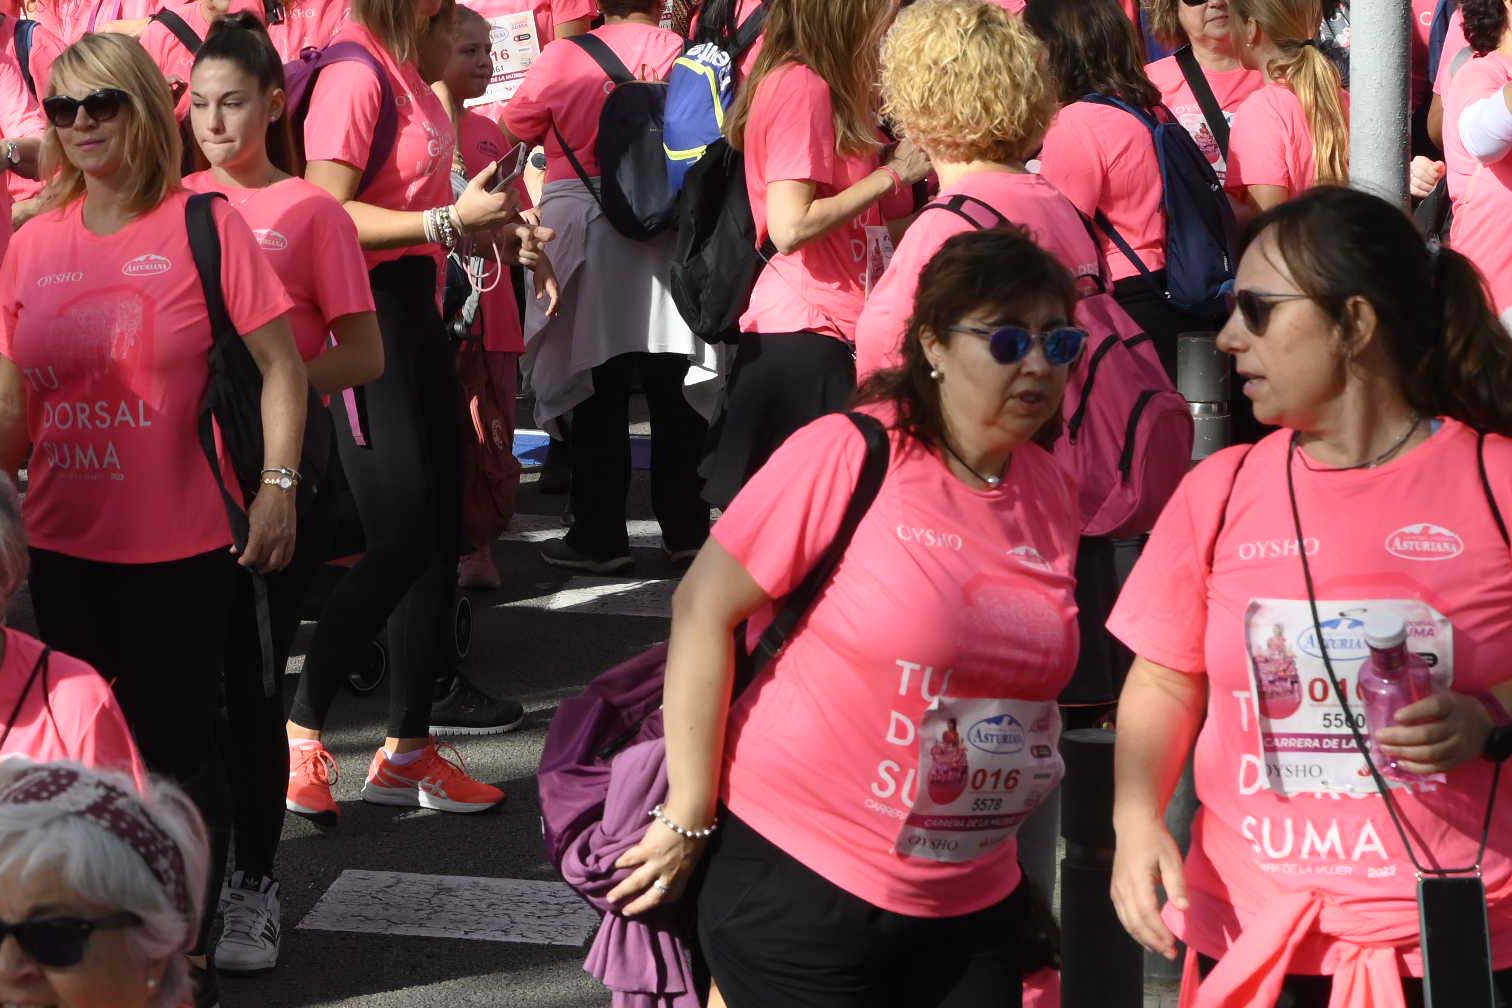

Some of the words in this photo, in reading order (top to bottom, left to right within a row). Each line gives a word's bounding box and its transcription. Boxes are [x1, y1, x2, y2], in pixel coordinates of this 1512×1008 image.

[491, 49, 510, 61] 16
[24, 366, 59, 392] TU
[43, 399, 152, 429] DORSAL
[44, 439, 121, 470] SUMA
[896, 522, 962, 552] OYSHO
[1238, 537, 1319, 560] OYSHO
[1391, 537, 1458, 553] ASTURIANA
[896, 658, 953, 702] TU
[1264, 738, 1322, 749] CARRERA
[1323, 738, 1338, 749] DE
[1339, 738, 1356, 749] LA
[972, 768, 1022, 791] 016
[972, 798, 1003, 811] 5578
[908, 834, 958, 851] OYSHO
[1242, 816, 1389, 860] SUMA
